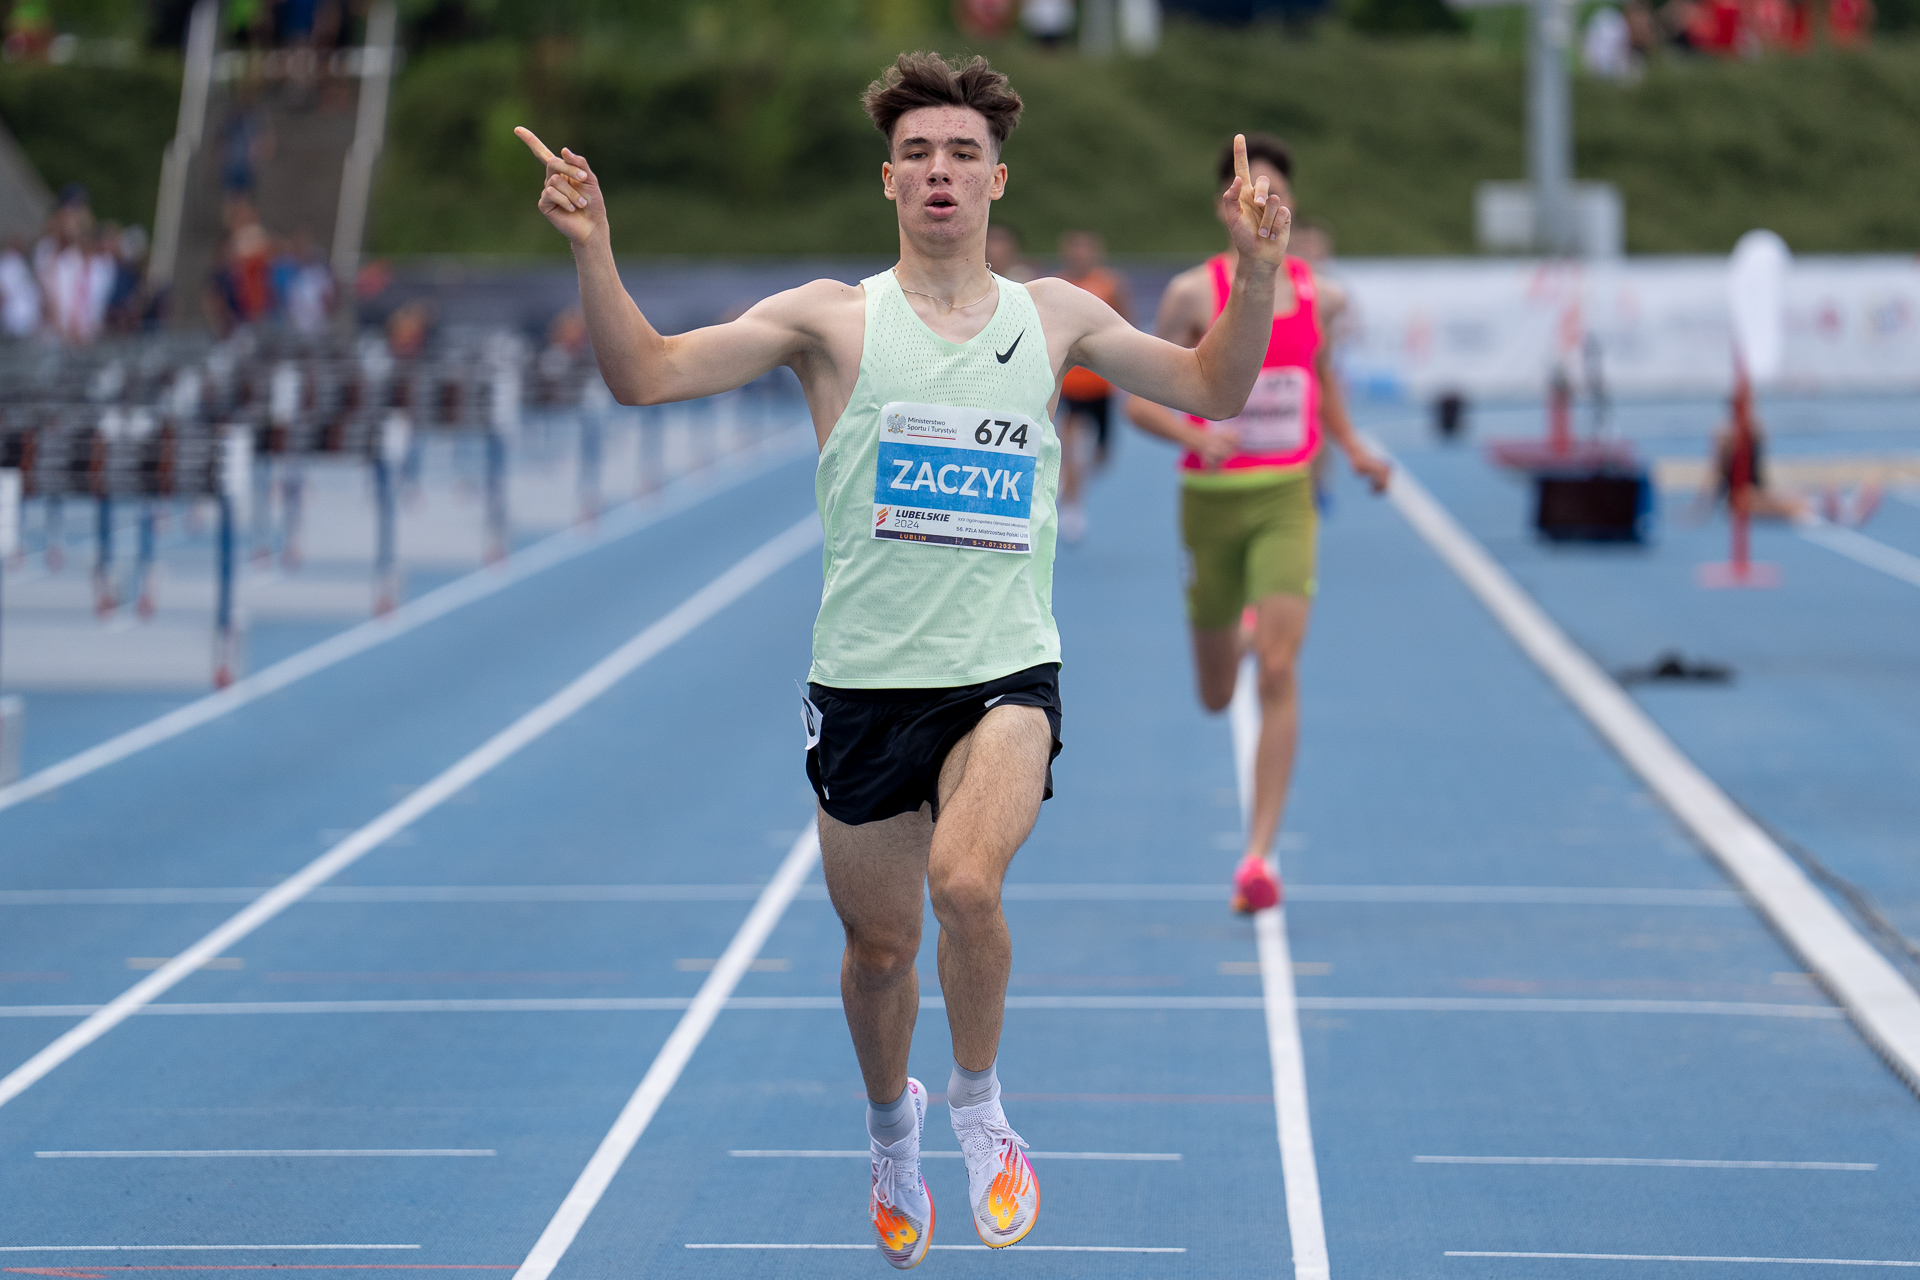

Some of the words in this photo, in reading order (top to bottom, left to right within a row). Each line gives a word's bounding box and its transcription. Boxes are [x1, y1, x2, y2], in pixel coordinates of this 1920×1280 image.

[907, 417, 946, 426] Ministerstwo
[907, 424, 927, 432] Sportu
[931, 426, 958, 434] Turystyki
[974, 418, 1029, 449] 674
[891, 459, 1023, 502] ZACZYK
[895, 509, 951, 522] LUBELSKIE
[894, 518, 920, 529] 2024
[899, 533, 927, 541] LUBLIN
[978, 529, 1005, 537] Mistrzostwa
[972, 540, 1017, 550] 5-7.07.2024
